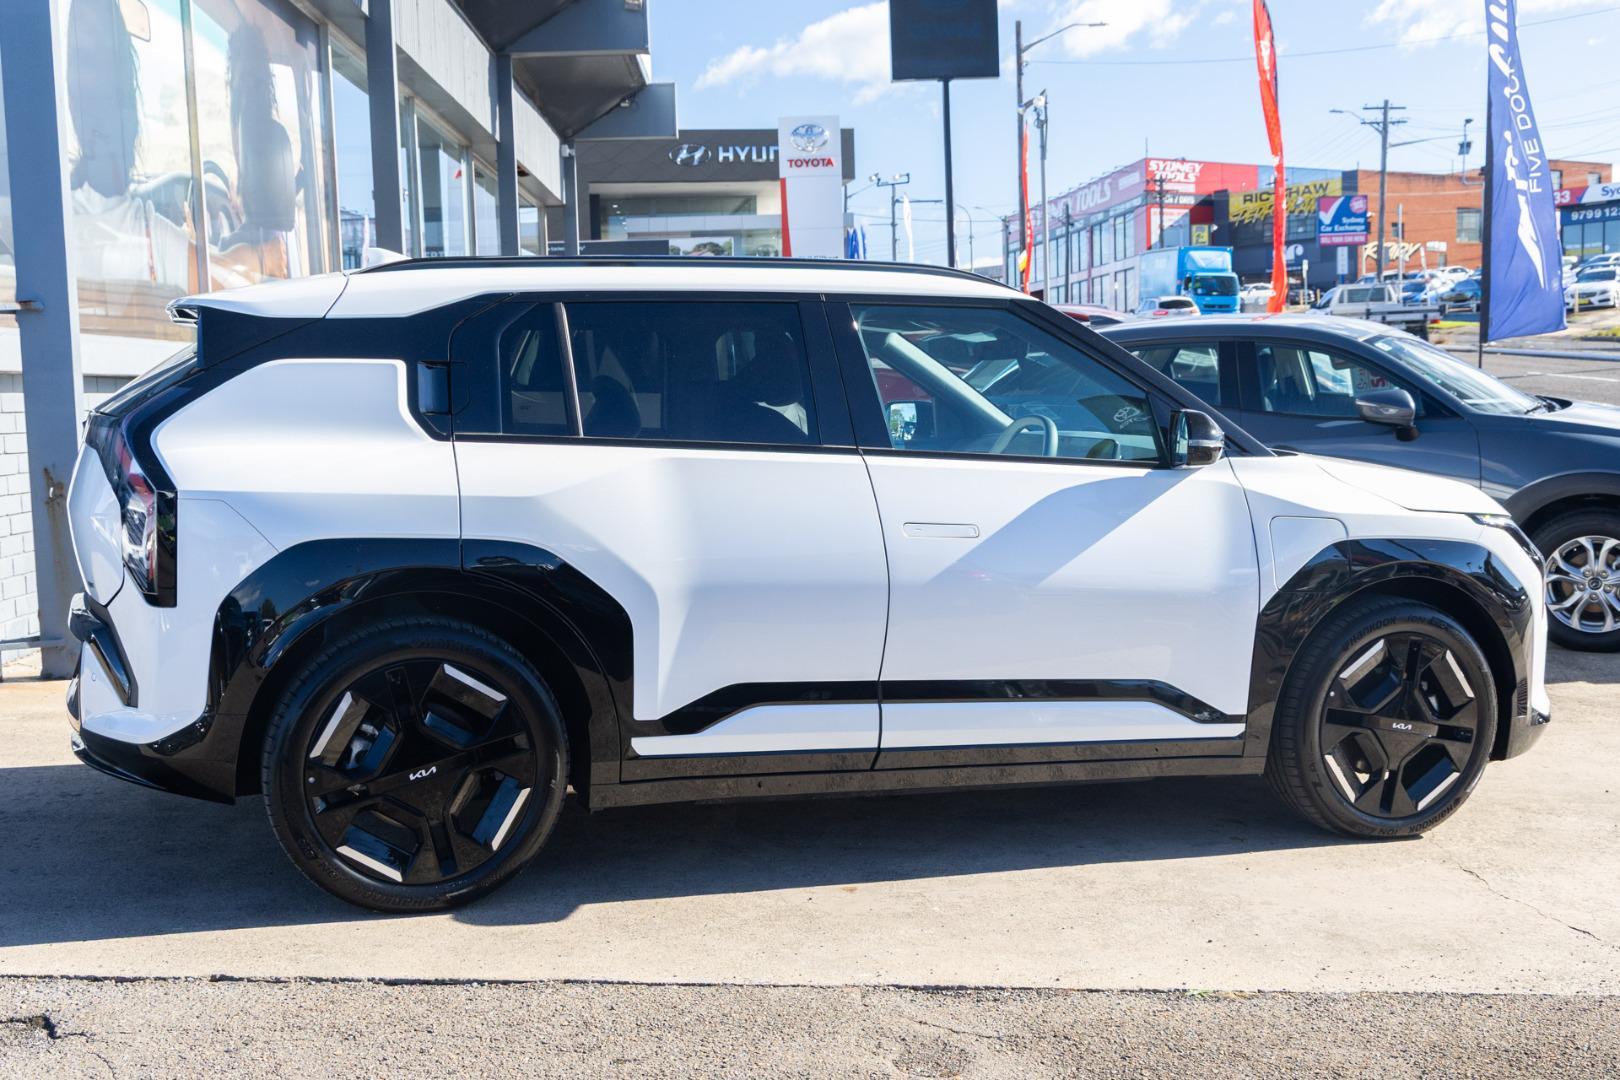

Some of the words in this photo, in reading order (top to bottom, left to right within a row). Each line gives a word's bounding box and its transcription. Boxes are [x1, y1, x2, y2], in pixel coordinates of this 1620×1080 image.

[787, 158, 834, 168] TOYOTA
[1148, 160, 1204, 173] SYDNEY
[1526, 139, 1542, 193] FIVE
[1154, 171, 1199, 183] TOOLS
[1074, 180, 1111, 213] TOOLS
[1243, 182, 1329, 205] RICHAW
[1571, 209, 1602, 221] 9799
[1604, 207, 1620, 217] 12
[1392, 722, 1412, 730] KIA
[409, 766, 437, 781] KIA
